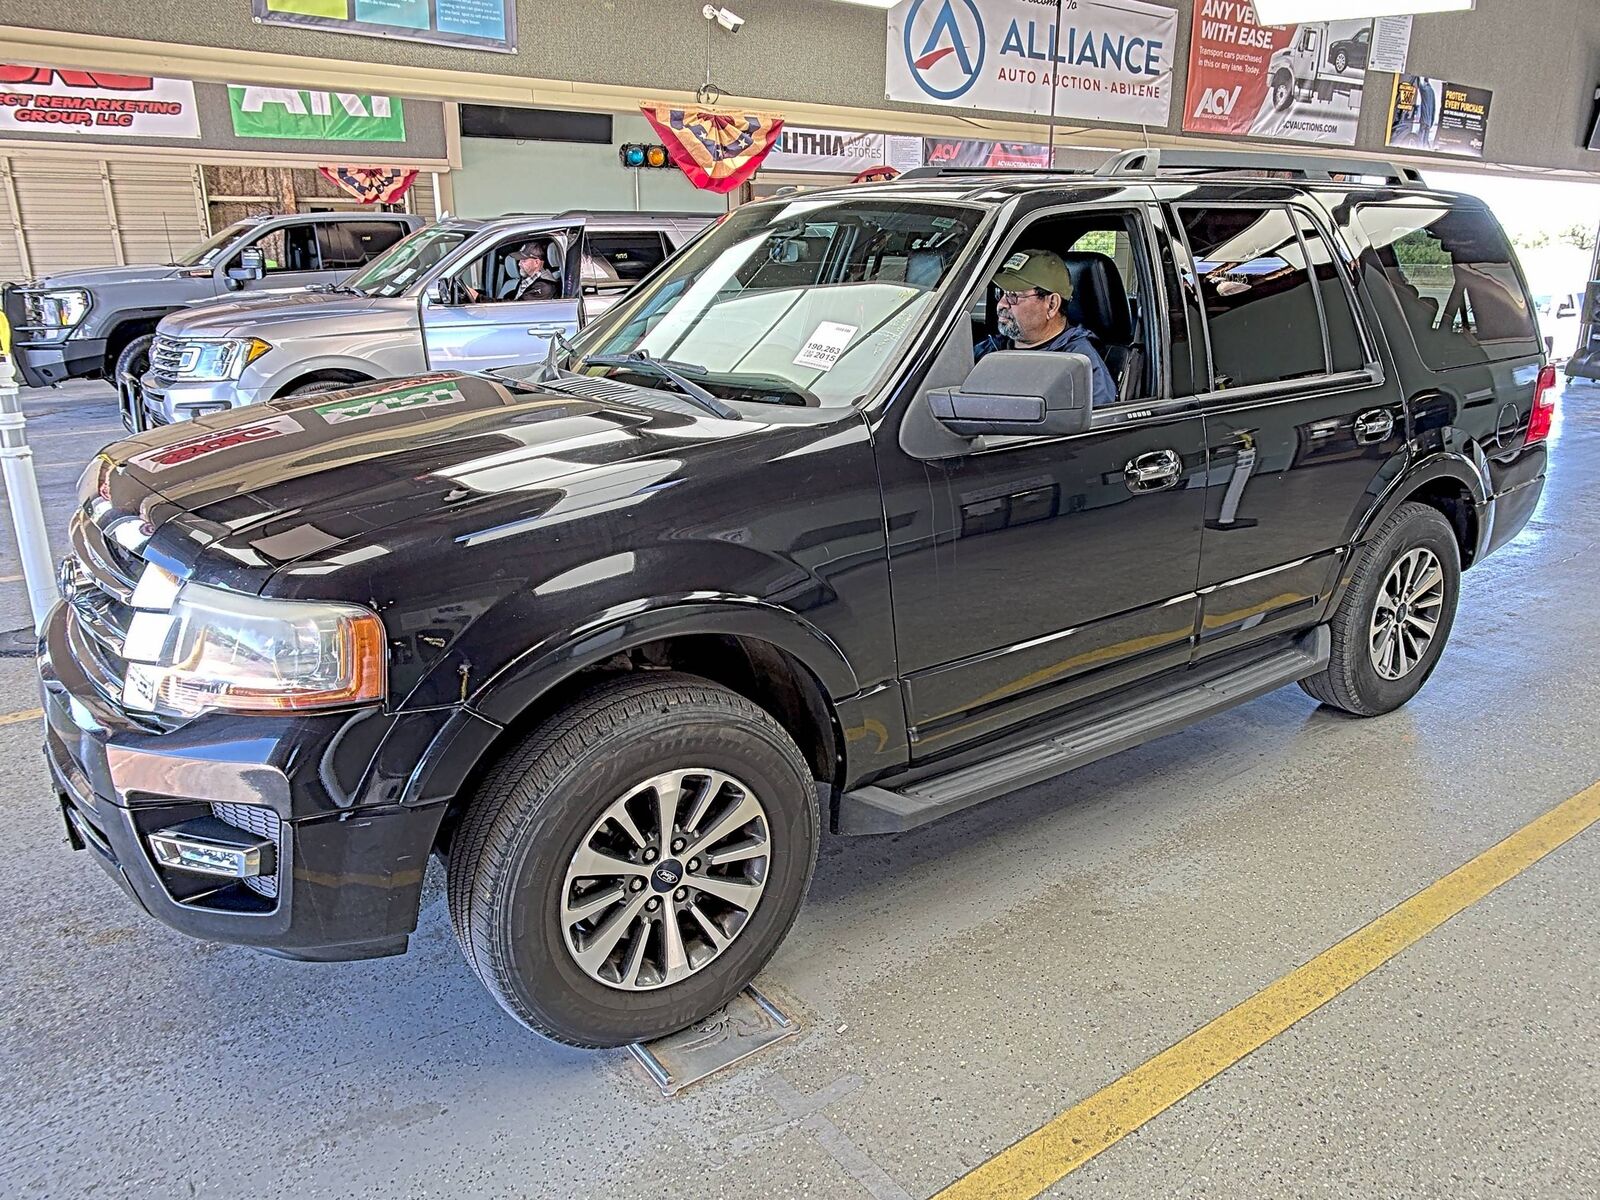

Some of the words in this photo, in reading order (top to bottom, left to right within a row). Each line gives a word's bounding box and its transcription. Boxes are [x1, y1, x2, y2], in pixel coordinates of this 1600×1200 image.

[1201, 0, 1234, 20] ANY
[1202, 19, 1237, 43] WITH
[1238, 28, 1274, 50] EASE.
[1000, 18, 1164, 76] ALLIANCE
[1199, 46, 1224, 58] Transport
[1224, 51, 1236, 59] cars
[1236, 53, 1263, 64] purchased
[1204, 59, 1214, 68] this
[1221, 62, 1231, 72] any
[1231, 63, 1243, 71] lane.
[1245, 64, 1260, 76] Today.
[998, 67, 1036, 84] AUTO
[1042, 73, 1101, 91] AUCTION
[1110, 81, 1160, 99] ABILENE
[1193, 85, 1242, 118] ACV
[1444, 100, 1460, 110] EVERY
[1445, 90, 1467, 101] PROTECT
[35, 95, 182, 116] REMARKETING
[14, 109, 94, 127] GROUP,
[96, 113, 134, 127] LLC
[782, 131, 846, 157] LITHIA
[847, 147, 882, 159] STORES
[929, 142, 962, 161] ACV
[813, 351, 837, 362] 2015
